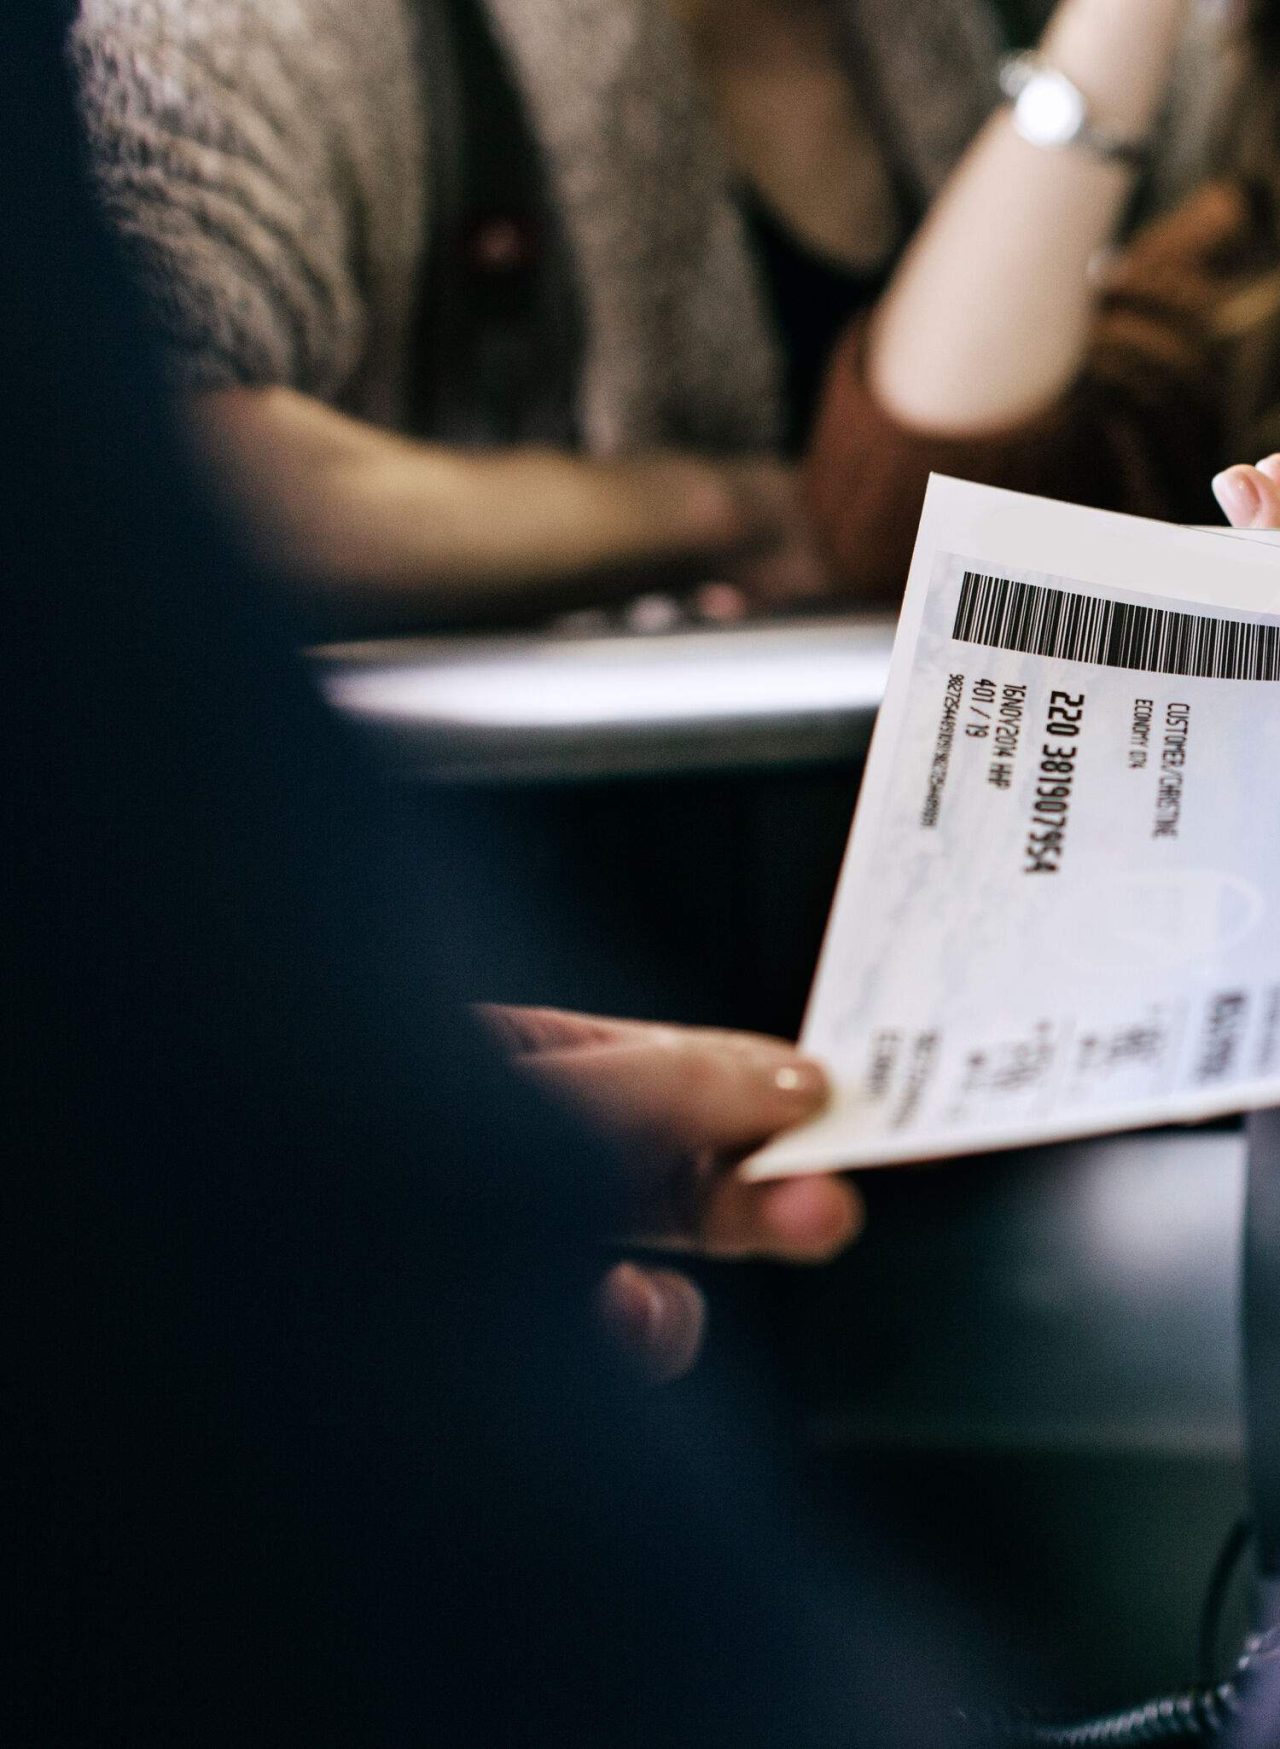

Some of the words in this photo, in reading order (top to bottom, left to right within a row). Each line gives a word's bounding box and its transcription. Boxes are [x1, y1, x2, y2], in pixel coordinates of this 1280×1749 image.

[971, 678, 997, 704] 401
[970, 706, 991, 719] /
[1046, 690, 1085, 737] 220
[1130, 698, 1154, 749] ECONOMY
[965, 723, 989, 739] 19
[1151, 702, 1190, 839] CUSTOMER/CHRISTINE
